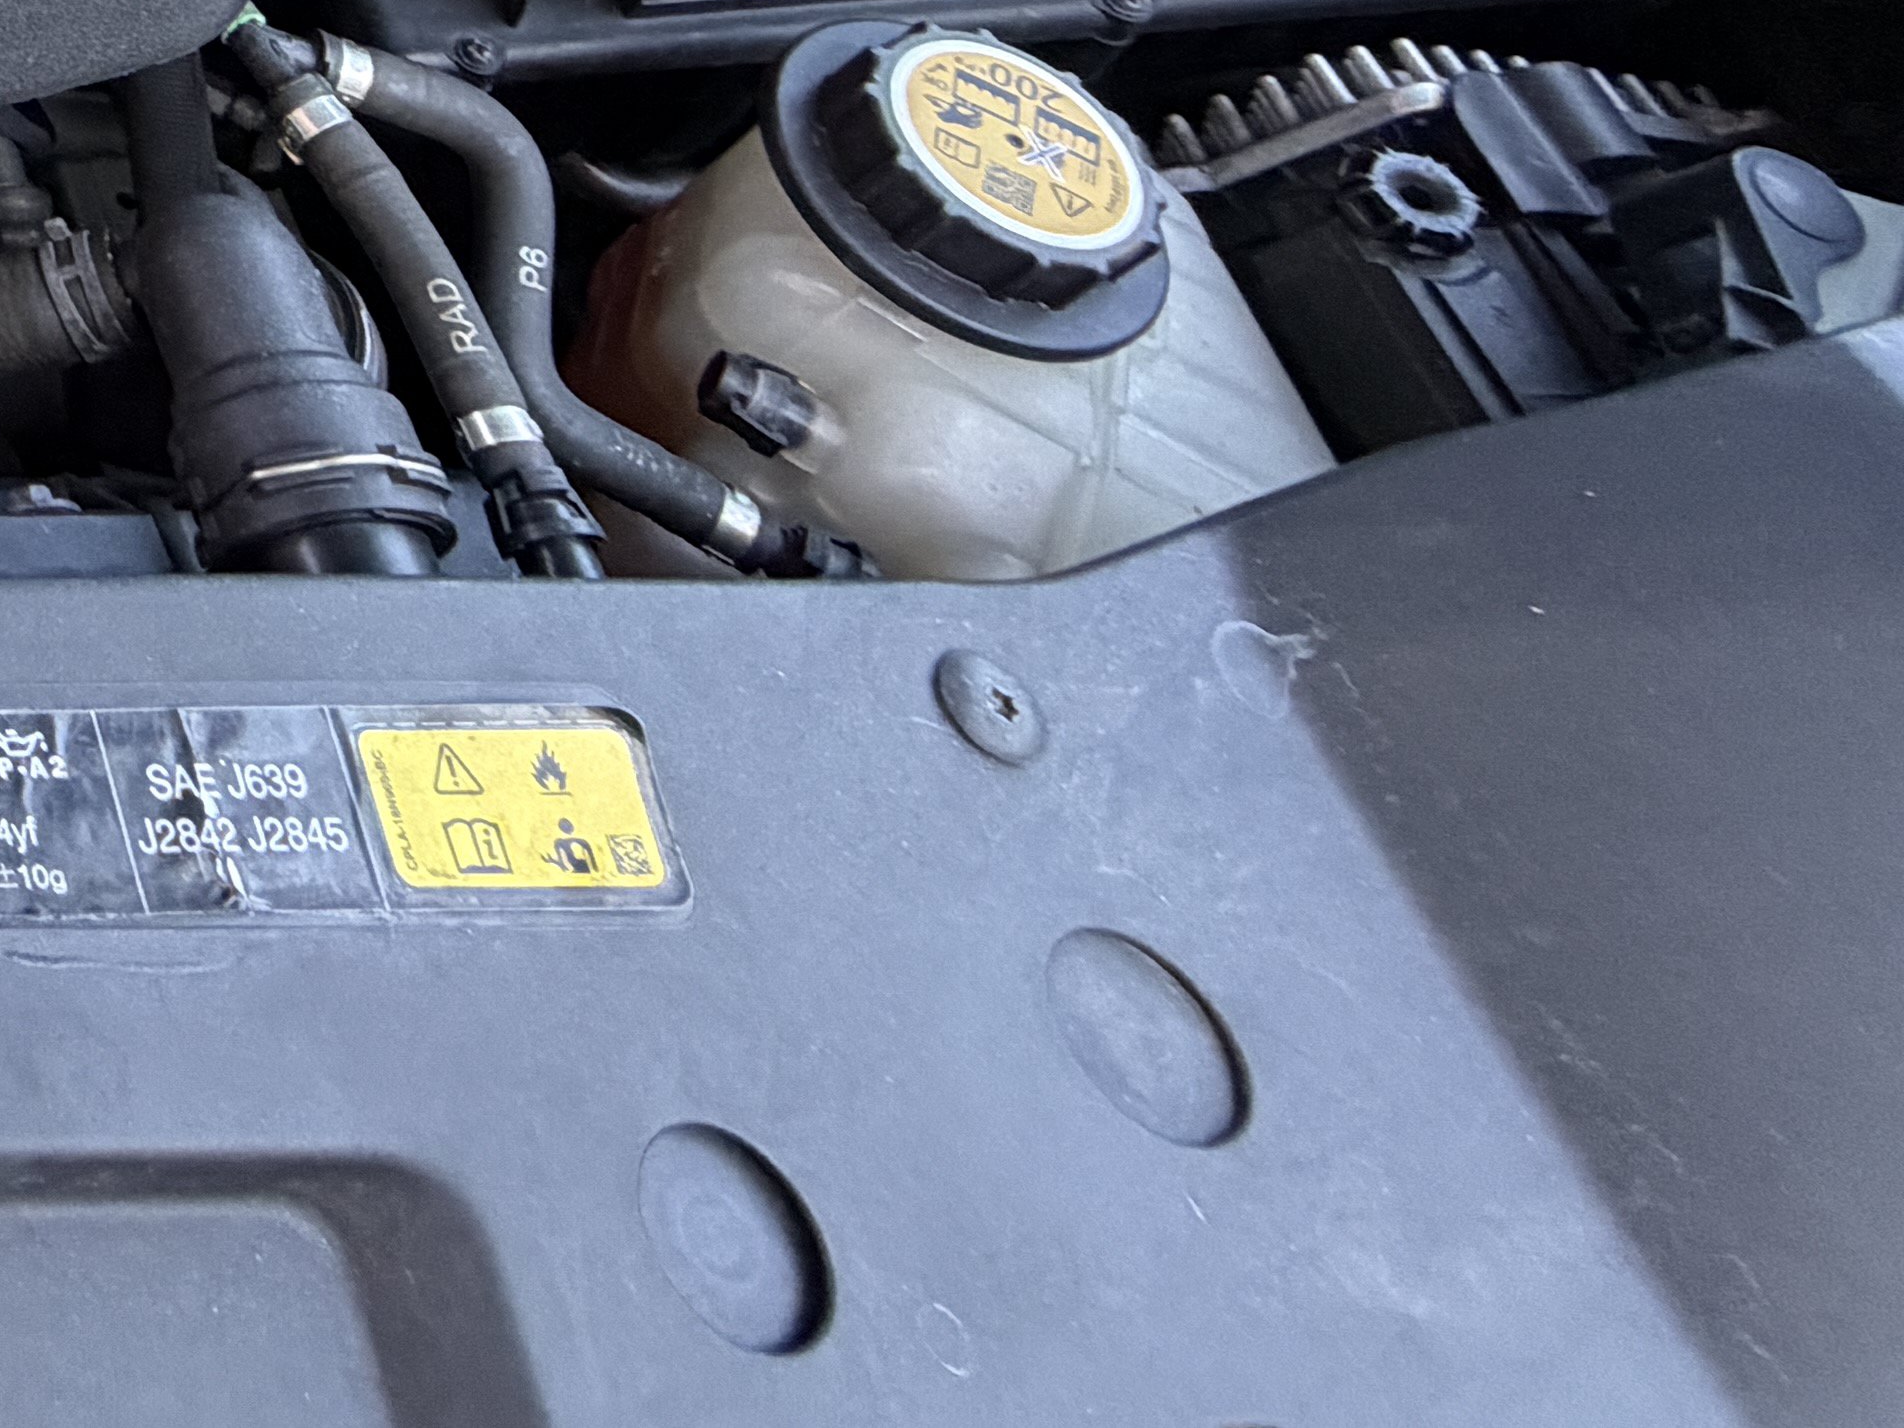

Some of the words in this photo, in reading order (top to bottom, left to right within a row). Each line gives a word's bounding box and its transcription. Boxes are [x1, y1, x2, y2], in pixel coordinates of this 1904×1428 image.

[518, 245, 549, 294] P6
[426, 277, 489, 354] RAD
[145, 762, 223, 802] SAE
[227, 762, 309, 801] J639
[138, 816, 242, 856] J2842
[248, 815, 350, 854] J2845
